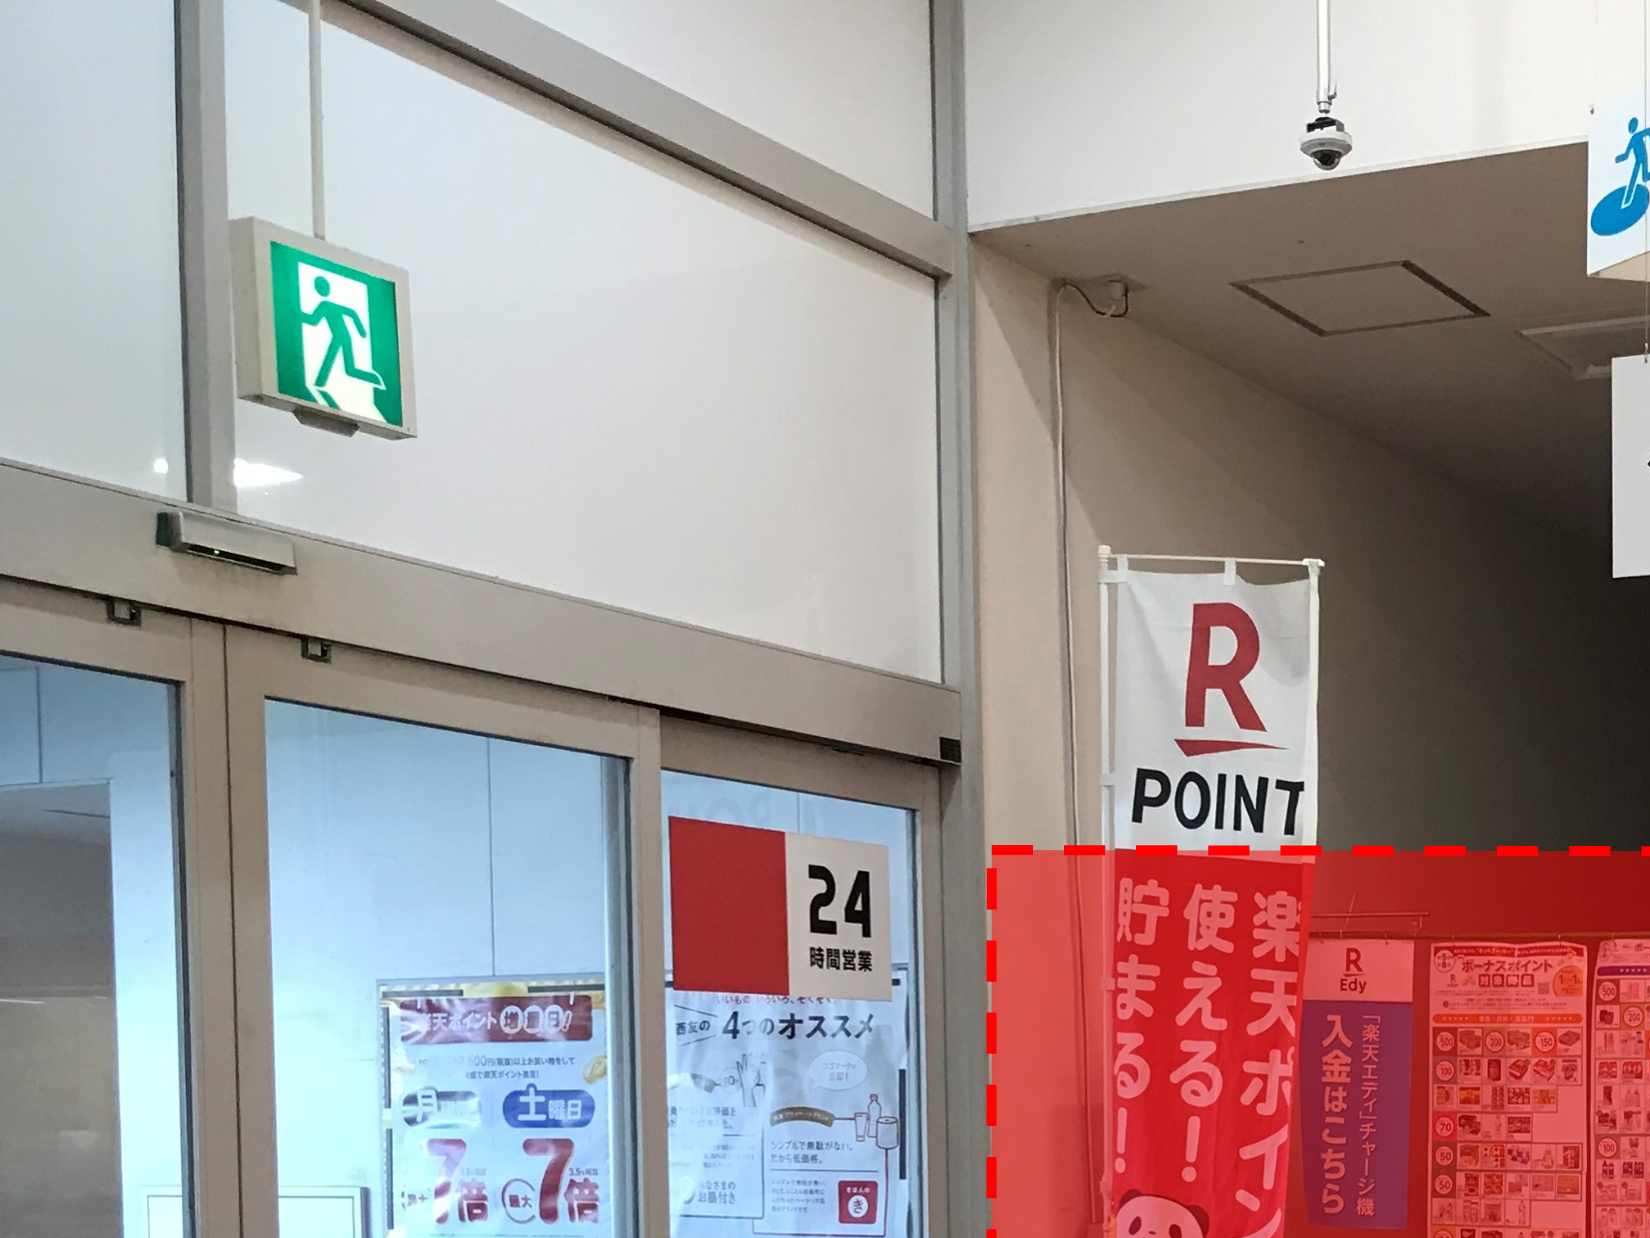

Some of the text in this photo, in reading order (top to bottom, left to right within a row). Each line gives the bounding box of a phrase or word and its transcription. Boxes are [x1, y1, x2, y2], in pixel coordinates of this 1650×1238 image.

[1185, 602, 1268, 732] R
[1131, 768, 1305, 836] POINT
[808, 864, 872, 938] 24
[809, 946, 873, 972] 時間営業
[1344, 947, 1364, 973] R
[1461, 959, 1553, 972] ボーナスポイント
[1339, 977, 1368, 995] Edy
[676, 1010, 874, 1040] 西友の 4つのオススメ
[1113, 878, 1171, 1174] 貯まる！
[1169, 883, 1239, 1184] 使える！
[517, 1087, 582, 1122] 土曜日
[1320, 1013, 1353, 1216] 入金はこちら
[1356, 1013, 1382, 1218] 「楽天エディ」チャージ機
[770, 1139, 854, 1152] シンプルで無駄がない。
[770, 1153, 823, 1165] だから低価格。
[522, 1138, 600, 1224] 7倍
[697, 1192, 737, 1204] お墨付き
[852, 1198, 864, 1214] き
